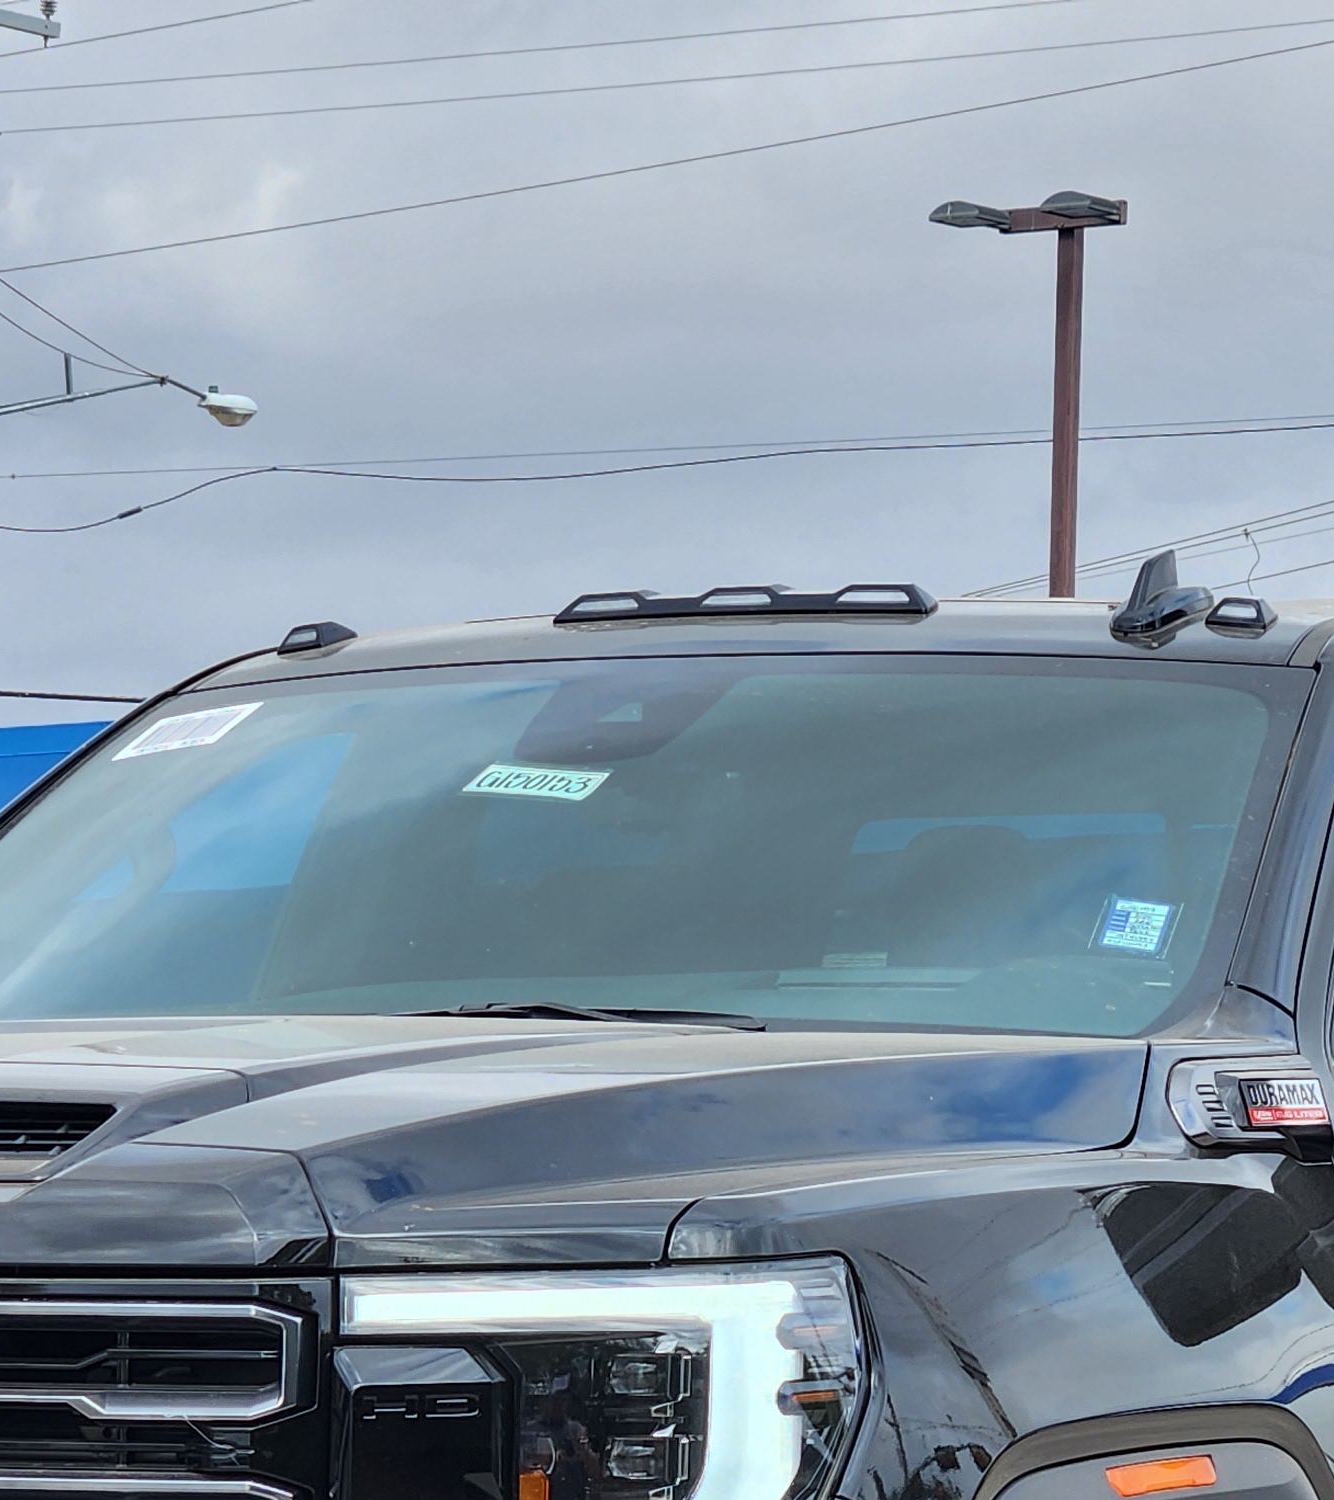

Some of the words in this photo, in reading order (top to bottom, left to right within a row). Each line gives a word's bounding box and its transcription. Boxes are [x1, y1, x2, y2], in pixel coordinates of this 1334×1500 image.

[475, 770, 593, 794] G150153
[1246, 1083, 1320, 1106] DURAMAX
[362, 1393, 480, 1420] HD
